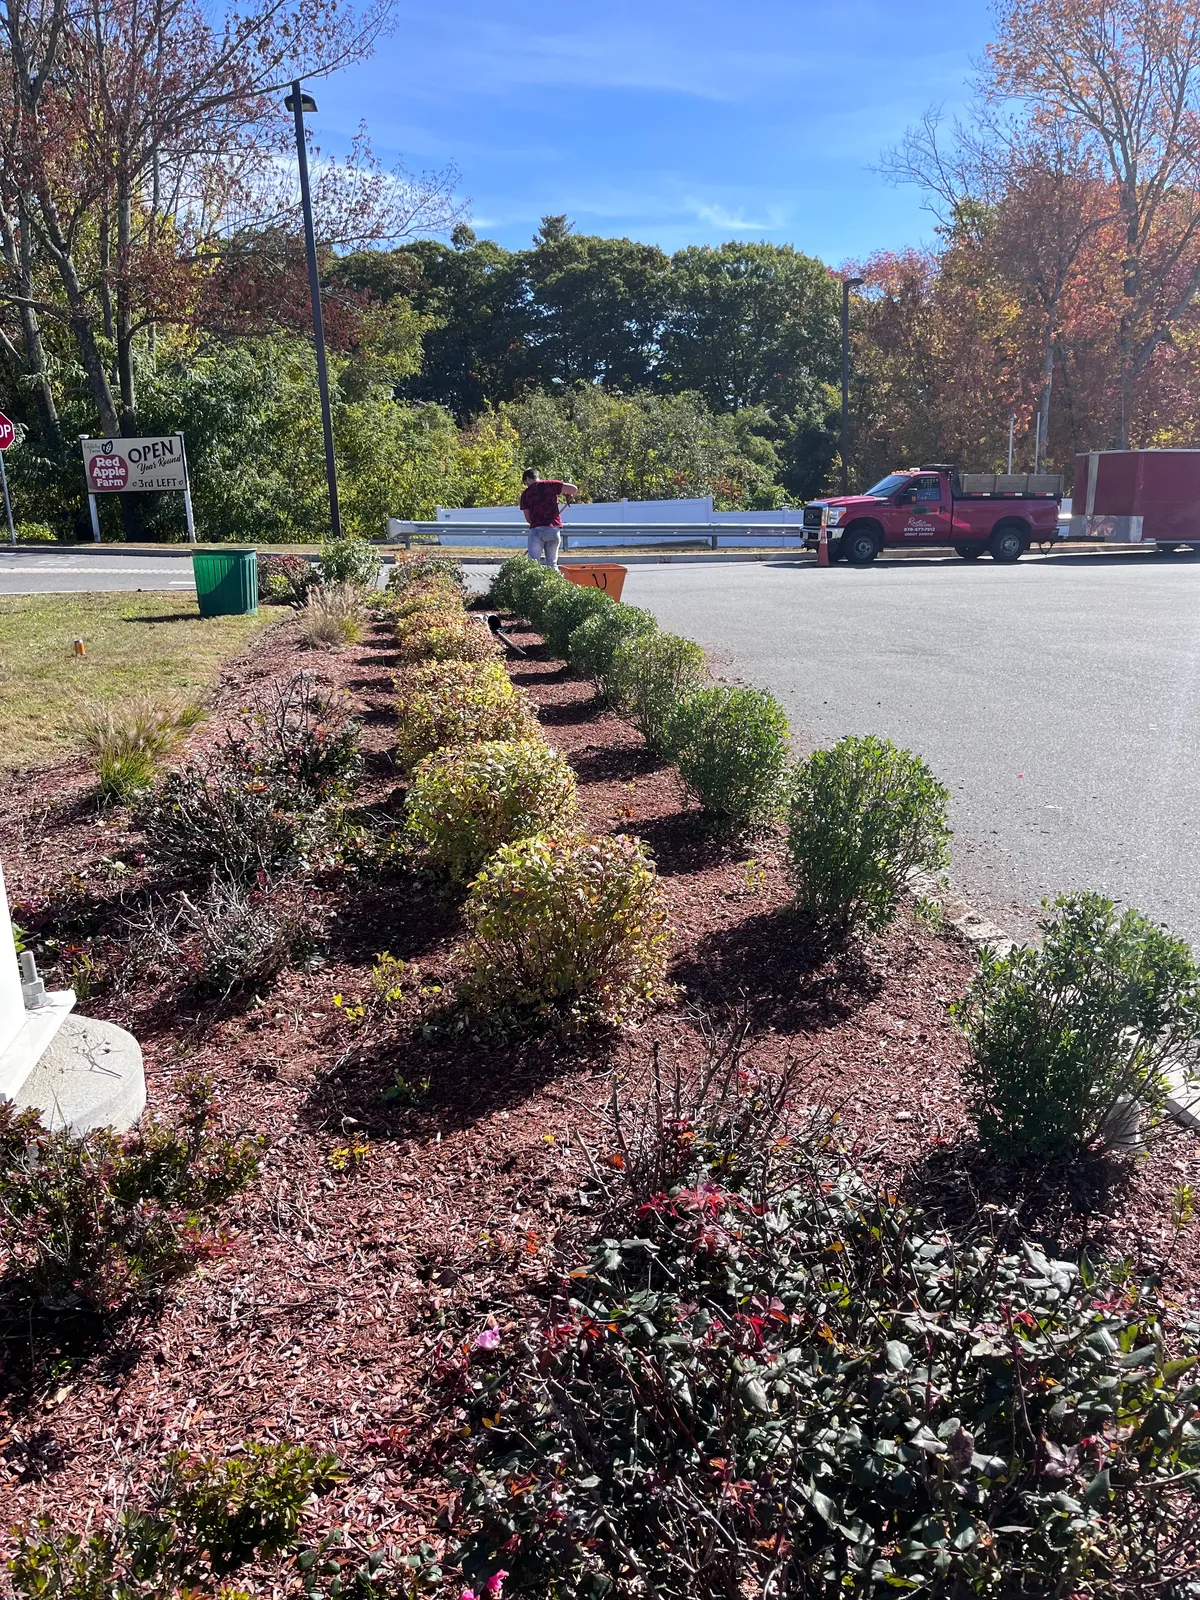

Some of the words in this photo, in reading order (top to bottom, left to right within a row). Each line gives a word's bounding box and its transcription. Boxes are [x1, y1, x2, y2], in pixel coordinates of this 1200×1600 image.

[128, 439, 174, 463] OPEN
[96, 456, 120, 467] Red
[136, 460, 157, 475] Year
[157, 454, 182, 468] Round
[93, 466, 126, 479] Apple
[96, 478, 124, 487] Farm
[138, 479, 154, 488] 3rd
[156, 478, 177, 488] LEFT
